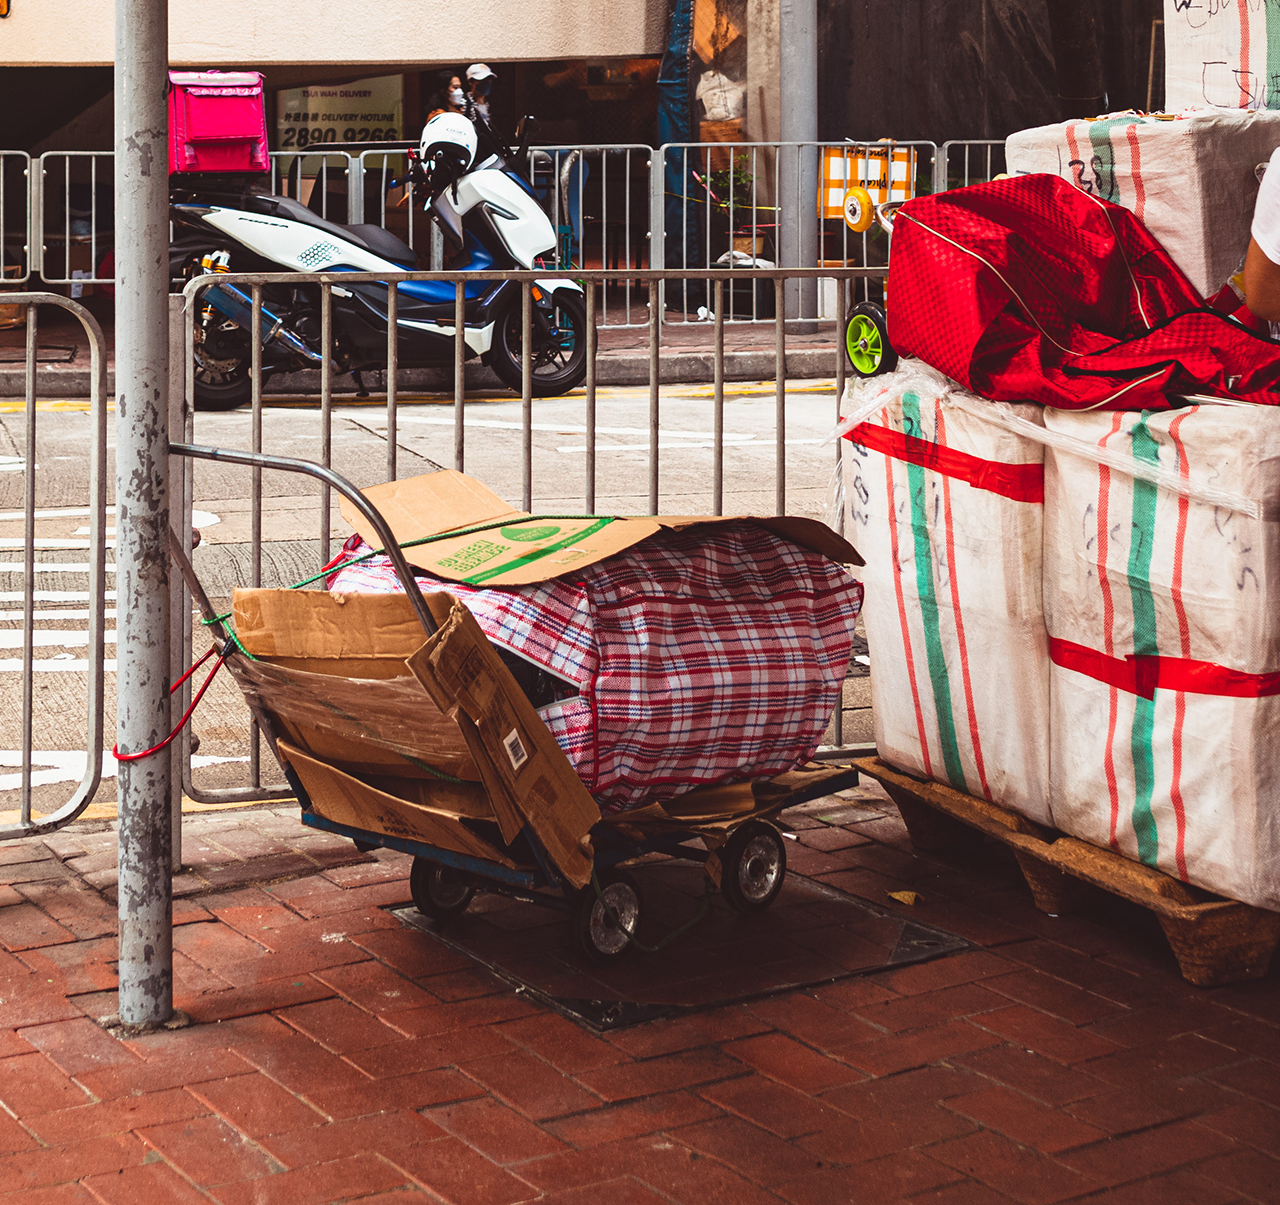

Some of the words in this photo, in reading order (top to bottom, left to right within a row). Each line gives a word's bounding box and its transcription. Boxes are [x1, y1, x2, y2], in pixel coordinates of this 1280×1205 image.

[302, 90, 318, 98] TSUI
[319, 90, 338, 98] WAH
[339, 90, 373, 98] DELIVERY
[320, 112, 360, 123] DELIVERY
[360, 112, 396, 123] HOTLINE
[281, 127, 337, 148] 2890
[341, 127, 399, 144] 9266
